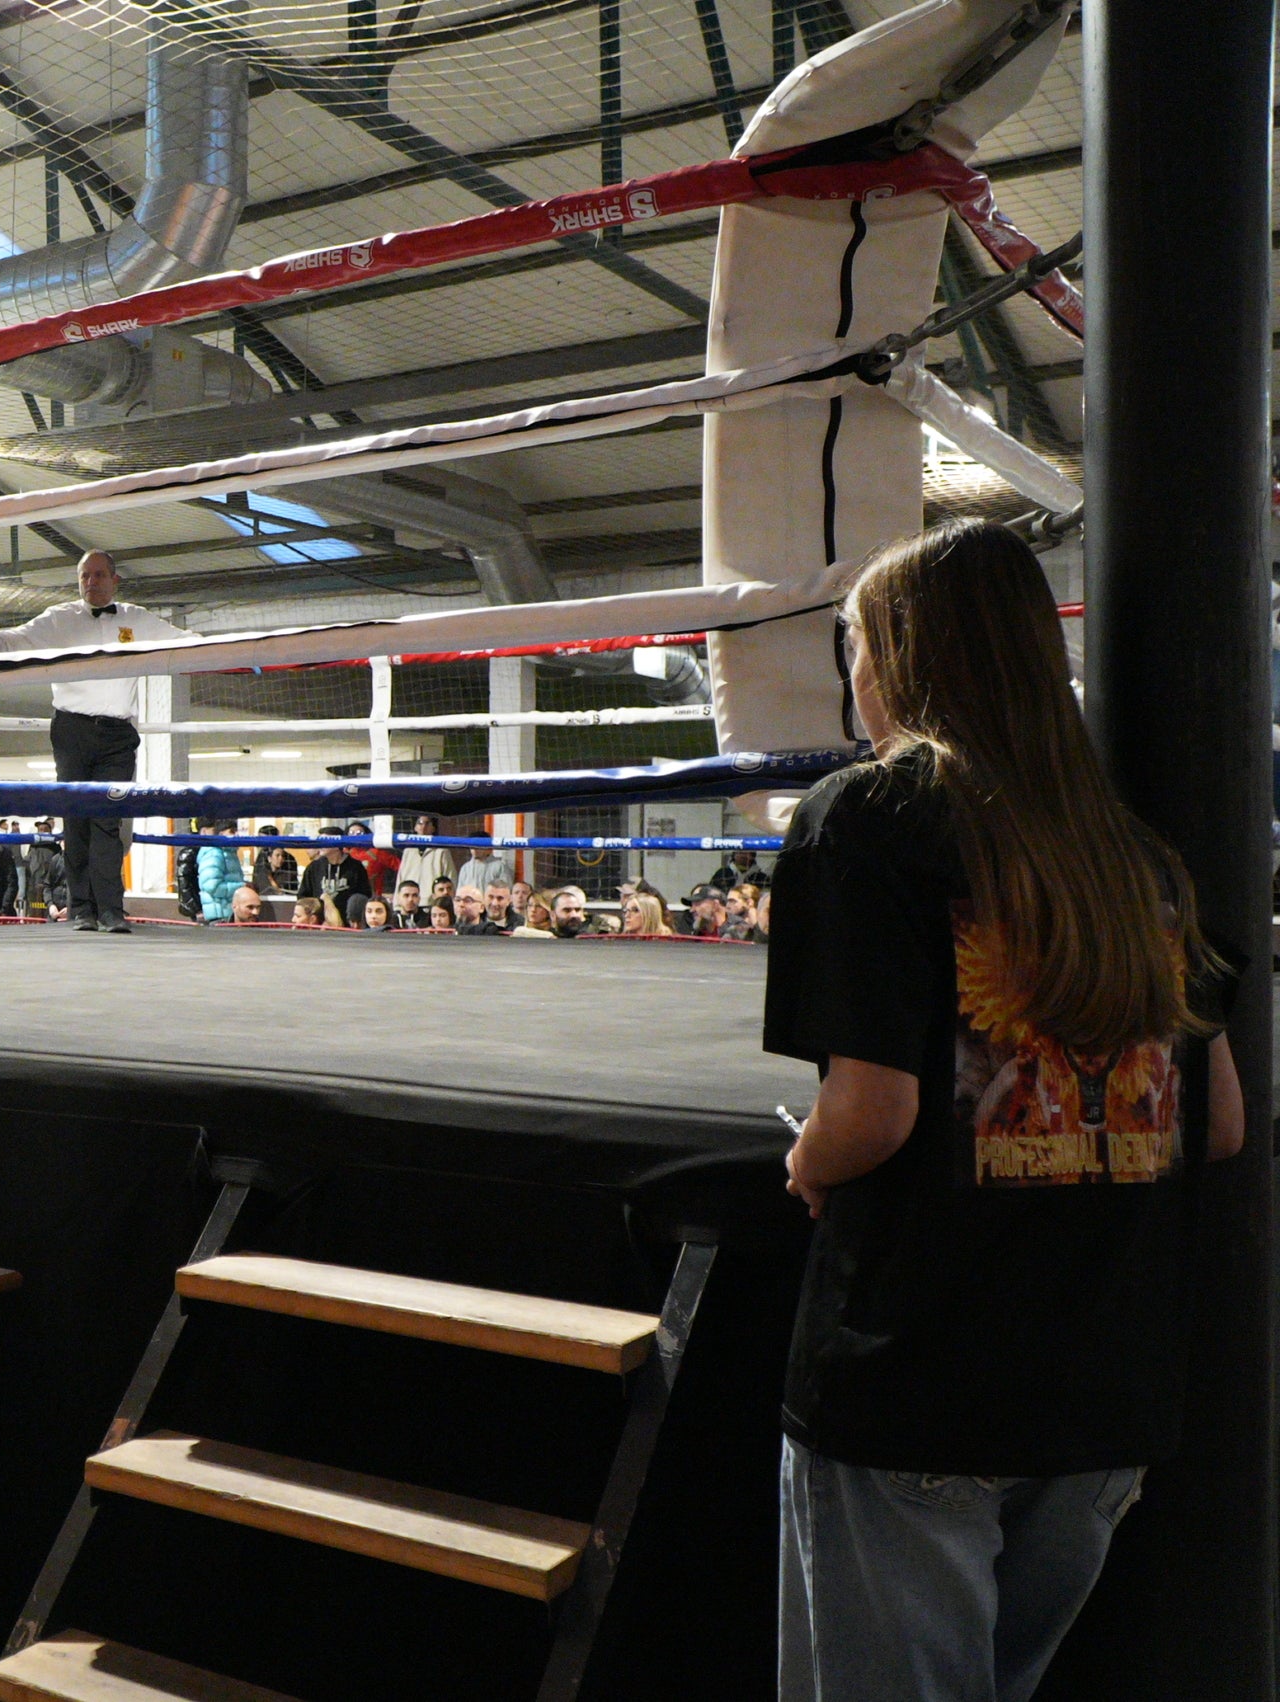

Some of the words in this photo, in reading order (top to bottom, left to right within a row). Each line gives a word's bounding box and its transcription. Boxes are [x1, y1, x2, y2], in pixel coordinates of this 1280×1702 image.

[548, 205, 623, 233] SHARK
[283, 252, 342, 273] SHARK
[86, 318, 142, 338] SHARK
